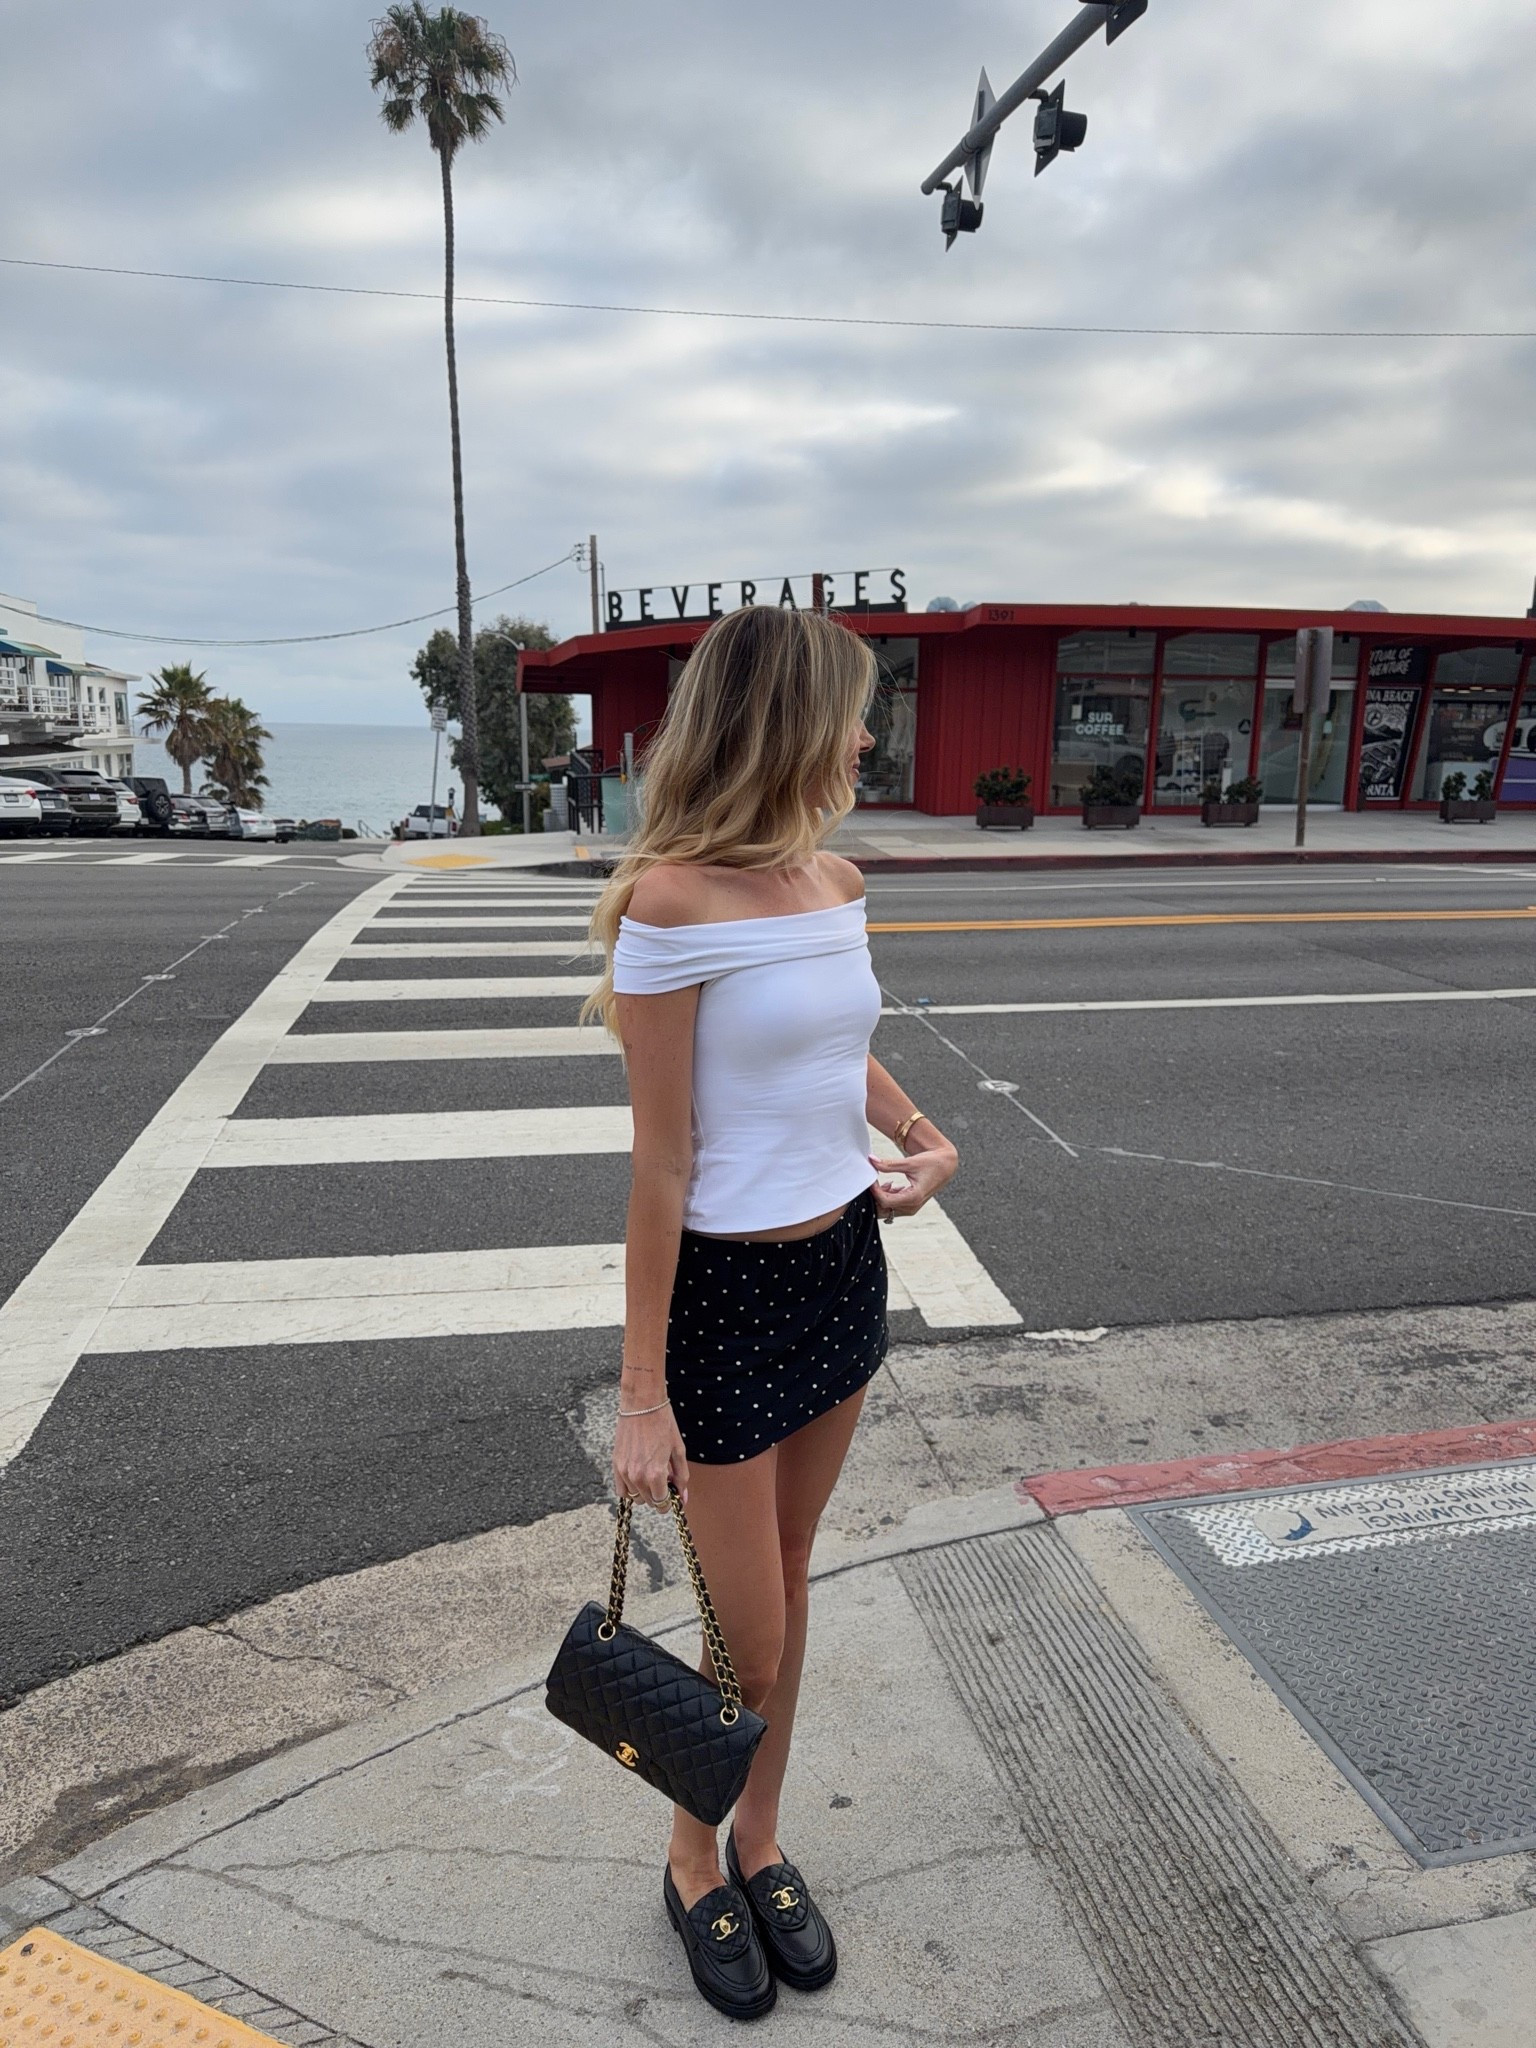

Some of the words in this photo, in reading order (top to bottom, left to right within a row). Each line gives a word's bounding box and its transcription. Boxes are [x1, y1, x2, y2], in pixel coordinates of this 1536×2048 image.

[608, 568, 906, 622] BEVERAGES
[1398, 648, 1413, 660] OF
[1382, 690, 1414, 702] BEACH
[1088, 712, 1113, 723] SUR
[1075, 724, 1124, 735] COFFEE
[1442, 1482, 1534, 1502] DRAINS
[1315, 1497, 1405, 1519] OCEAN
[1490, 1497, 1534, 1511] NO
[1358, 1503, 1489, 1529] DUMPING!
